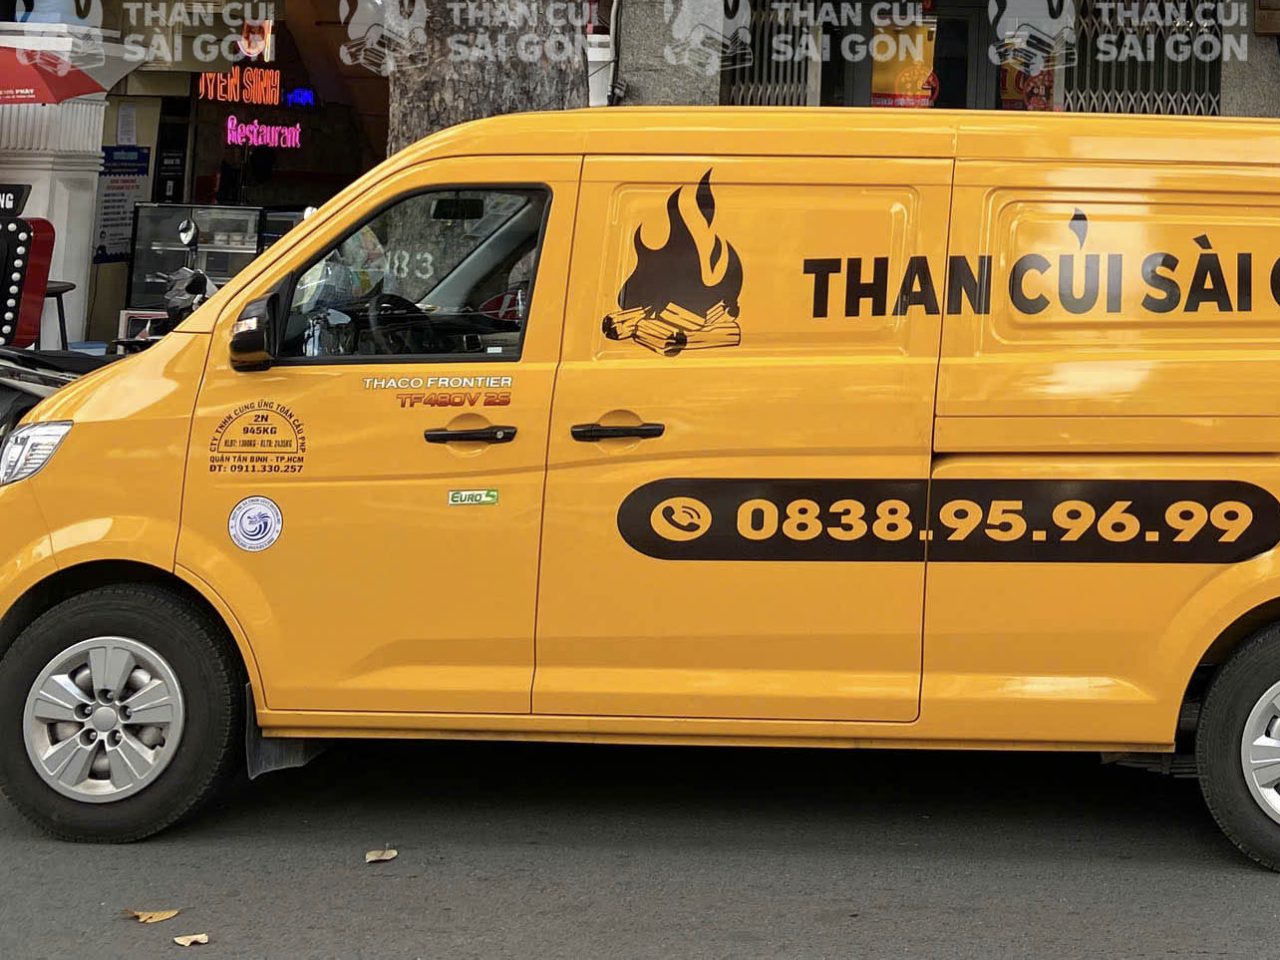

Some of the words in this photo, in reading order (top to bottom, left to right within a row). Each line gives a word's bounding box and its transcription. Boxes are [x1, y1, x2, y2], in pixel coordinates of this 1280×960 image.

[805, 256, 992, 318] THAN
[1009, 208, 1123, 314] CỦI
[1142, 236, 1254, 312] SÀI
[363, 377, 423, 389] THACO
[427, 376, 513, 388] FRONTIER
[253, 414, 269, 422] 2N
[242, 427, 277, 435] 945KG
[230, 464, 304, 473] 0911.330.257
[736, 497, 1254, 545] 0838.95.96.99
